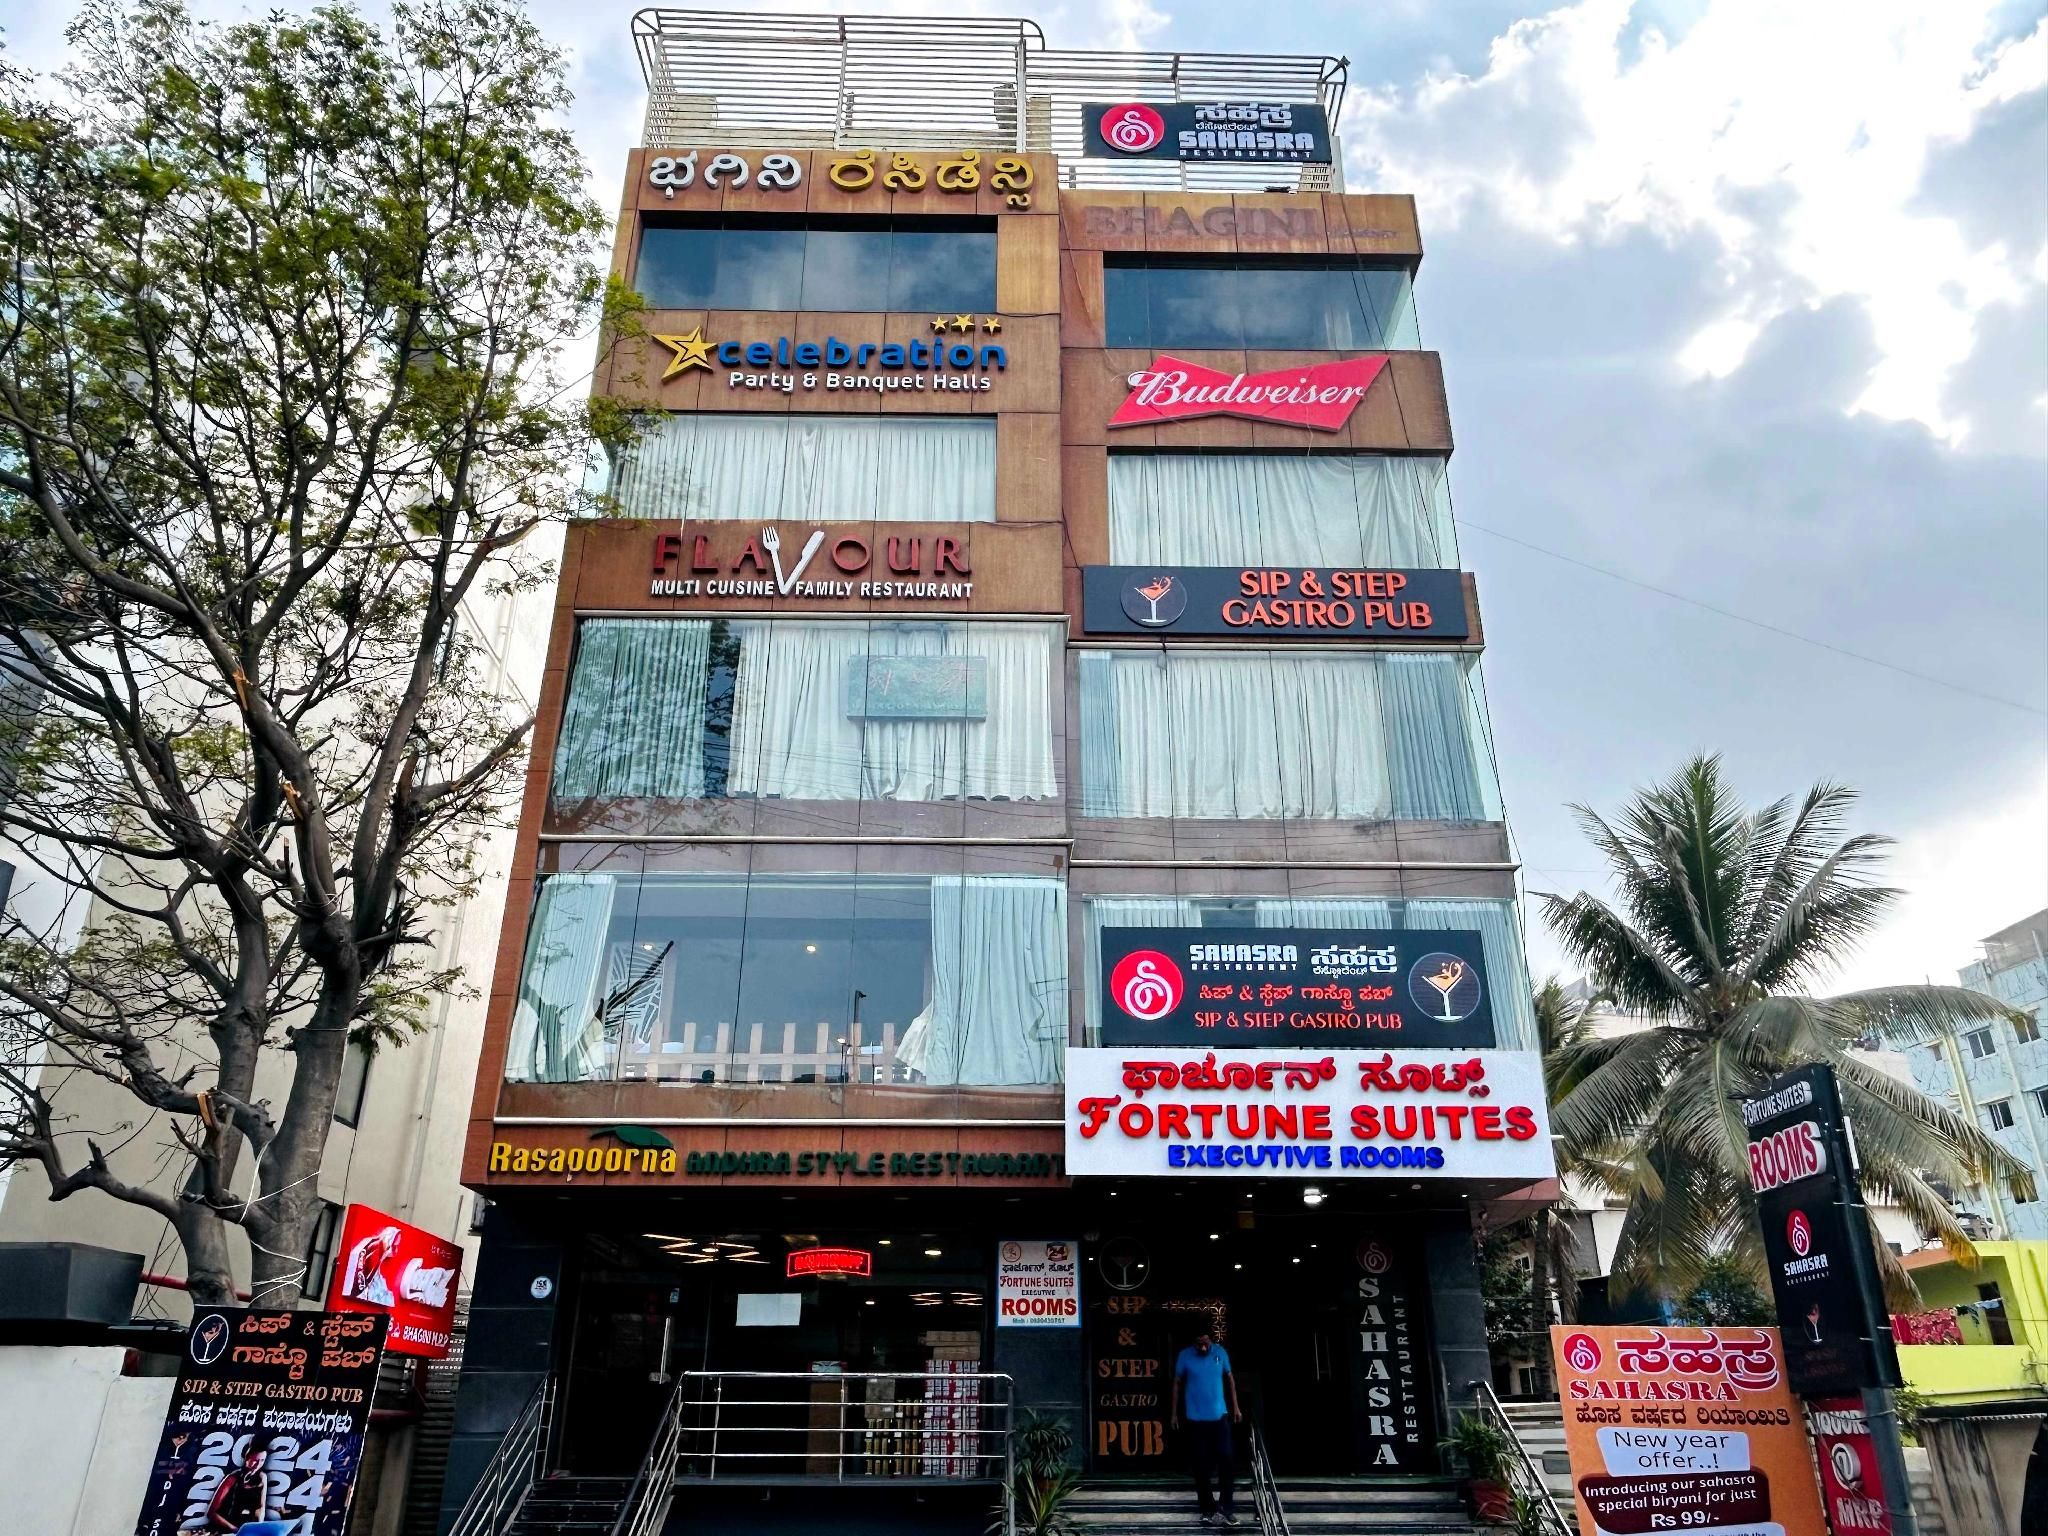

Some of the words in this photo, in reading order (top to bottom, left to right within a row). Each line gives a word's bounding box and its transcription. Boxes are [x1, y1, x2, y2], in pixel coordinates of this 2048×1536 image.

[1179, 131, 1314, 150] SAHASRA
[650, 151, 801, 198] ಭಗಿನಿ
[829, 149, 1035, 209] ರೆಸಿಡೆನ್ಸಿ
[1084, 206, 1319, 238] BHAGINI
[718, 336, 1007, 370] celebration
[729, 372, 794, 393] Party
[803, 373, 818, 388] &
[826, 373, 925, 393] Banquet
[933, 374, 991, 391] Halls
[1128, 370, 1365, 406] Budweiser
[653, 526, 970, 595] FLAVOUR
[652, 580, 700, 595] MULTI
[706, 579, 774, 596] CUISINE
[795, 581, 853, 597] FAMILY
[860, 581, 973, 599] RESTAURANT
[1239, 571, 1291, 597] SIP
[1299, 571, 1325, 596] &
[1331, 572, 1407, 598] STEP
[1222, 601, 1356, 627] GASTRO
[1365, 602, 1433, 629] PUB
[1190, 945, 1298, 962] SAHASRA
[1311, 945, 1398, 973] ಸಹಸ್ರ
[1200, 985, 1233, 999] ಸಿಪ್
[1240, 985, 1253, 1000] &
[1359, 985, 1393, 1000] ಪಬ್
[1194, 1012, 1222, 1028] SIP
[1227, 1012, 1239, 1028] &
[1244, 1013, 1285, 1028] STEP
[1289, 1013, 1360, 1029] GASTRO
[1366, 1014, 1402, 1029] PUB
[1742, 1094, 1777, 1126] FORTUNE
[1775, 1082, 1806, 1112] SUITES
[1077, 1095, 1332, 1140] FORTUNE
[1350, 1105, 1537, 1141] SUITES
[489, 1142, 677, 1179] Rasapoorna
[686, 1151, 792, 1176] ANDHRA
[796, 1151, 885, 1176] STYLE
[1168, 1144, 1332, 1168] EXECUTIVE
[1340, 1145, 1444, 1169] ROOMS
[1747, 1121, 1819, 1193] ROOMS
[1784, 1253, 1829, 1276] SAHASRA
[1000, 1276, 1041, 1287] FORTUNE
[1044, 1277, 1073, 1287] SUITES
[1002, 1298, 1076, 1316] ROOMS
[1107, 1297, 1146, 1314] SIP
[239, 1313, 293, 1333] ಸಿಪ್
[303, 1321, 315, 1336] &
[1118, 1328, 1136, 1345] &
[321, 1346, 376, 1368] ಪಬ್
[1098, 1359, 1159, 1378] STEP
[1616, 1329, 1780, 1391] ಸಹಸ್ರ
[1358, 1278, 1399, 1465] SAHASRA
[182, 1379, 208, 1394] SIP
[210, 1381, 222, 1394] &
[224, 1382, 263, 1397] STEP
[265, 1384, 328, 1401] GASTRO
[331, 1388, 364, 1403] PUB
[1100, 1394, 1158, 1407] GASTRO
[1569, 1380, 1739, 1401] SAHASRA
[178, 1400, 214, 1424] ಹೊಸ
[216, 1403, 259, 1429] ವರ್ಷದ
[1576, 1403, 1621, 1425] ಹೊಸ
[1631, 1404, 1687, 1427] ವರ್ಷದ
[1697, 1405, 1790, 1426] ರಿಯಾಯಿತಿ
[1098, 1421, 1164, 1456] PUB
[1614, 1431, 1667, 1448] New
[1674, 1433, 1730, 1452] year
[1585, 1481, 1667, 1498] Introducing
[1671, 1479, 1695, 1490] our
[1699, 1475, 1756, 1488] sahasra
[1598, 1497, 1648, 1513] special
[1652, 1492, 1701, 1508] biryani
[1705, 1490, 1726, 1505] for
[1730, 1489, 1757, 1502] just
[1651, 1514, 1677, 1527] Rs
[1680, 1511, 1720, 1525] 99/-
